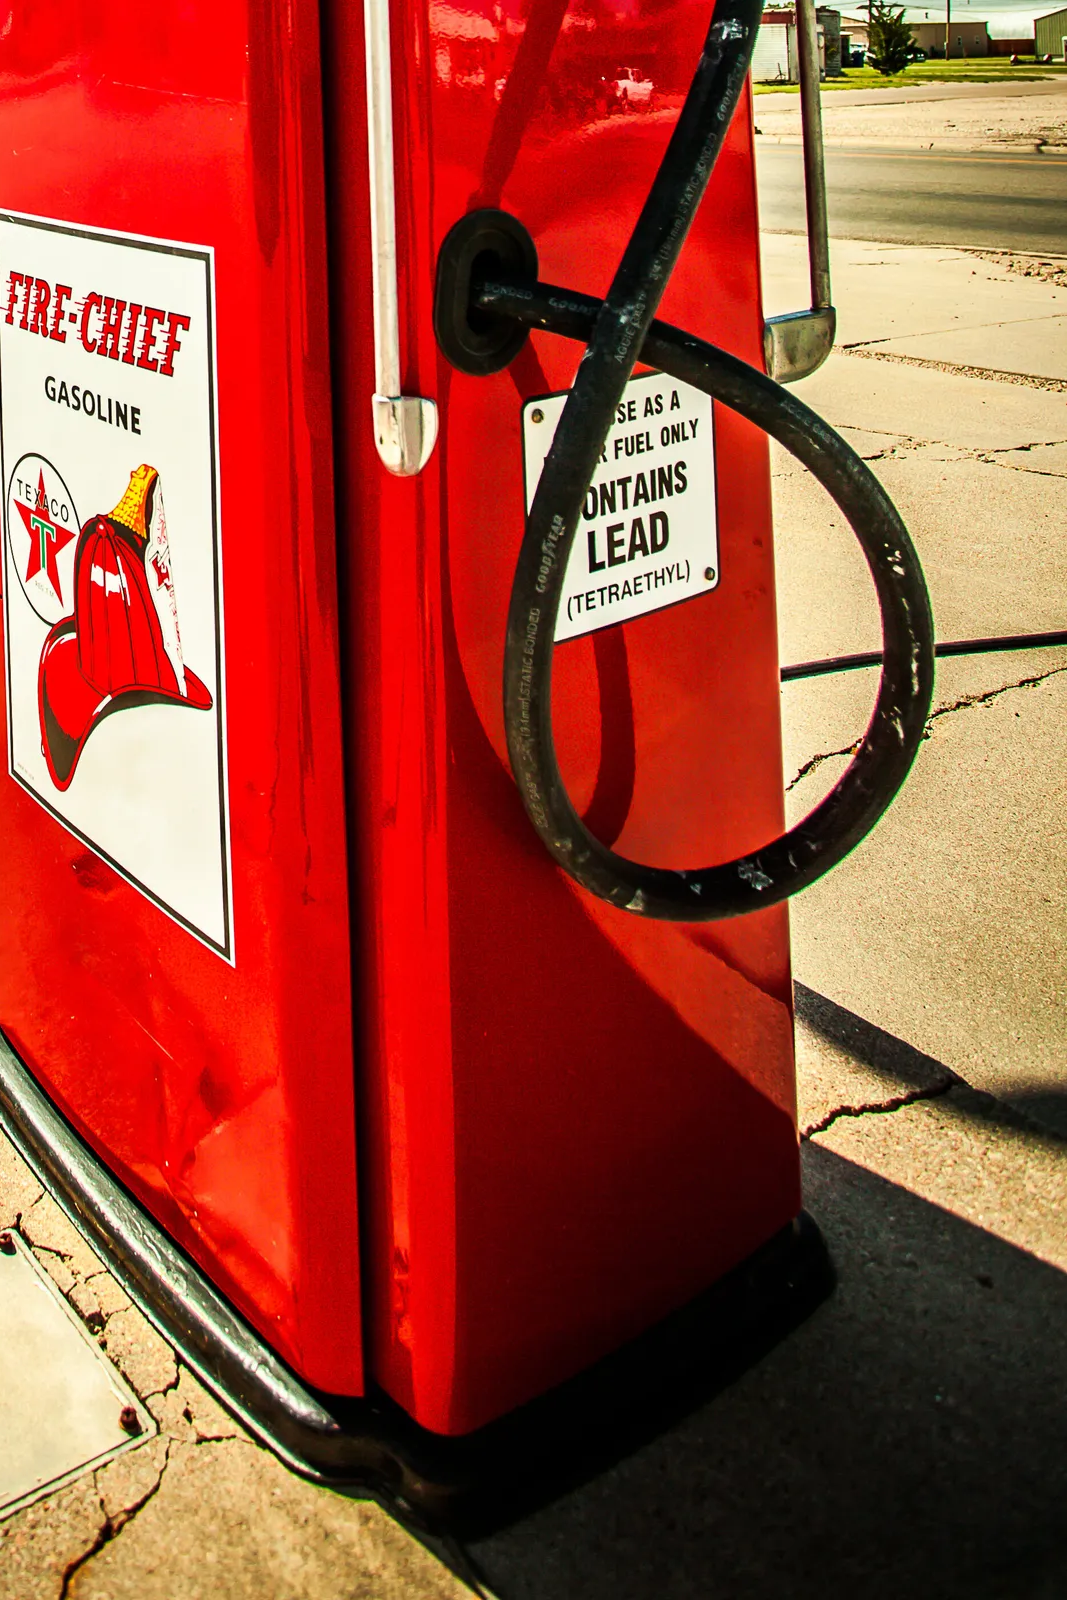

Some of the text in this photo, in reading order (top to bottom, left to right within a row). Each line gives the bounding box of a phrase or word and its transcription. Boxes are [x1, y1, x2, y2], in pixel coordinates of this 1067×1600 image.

[3, 271, 191, 377] FIRE-CHIEF
[44, 374, 142, 435] GASOLINE
[611, 389, 681, 425] SE AS A
[614, 431, 654, 460] FUEL
[660, 418, 700, 447] ONLY
[16, 478, 69, 523] TEXACO
[582, 460, 688, 521] ONTAINS
[587, 510, 670, 574] LEAD
[567, 559, 692, 622] (TETRAETHYL)
